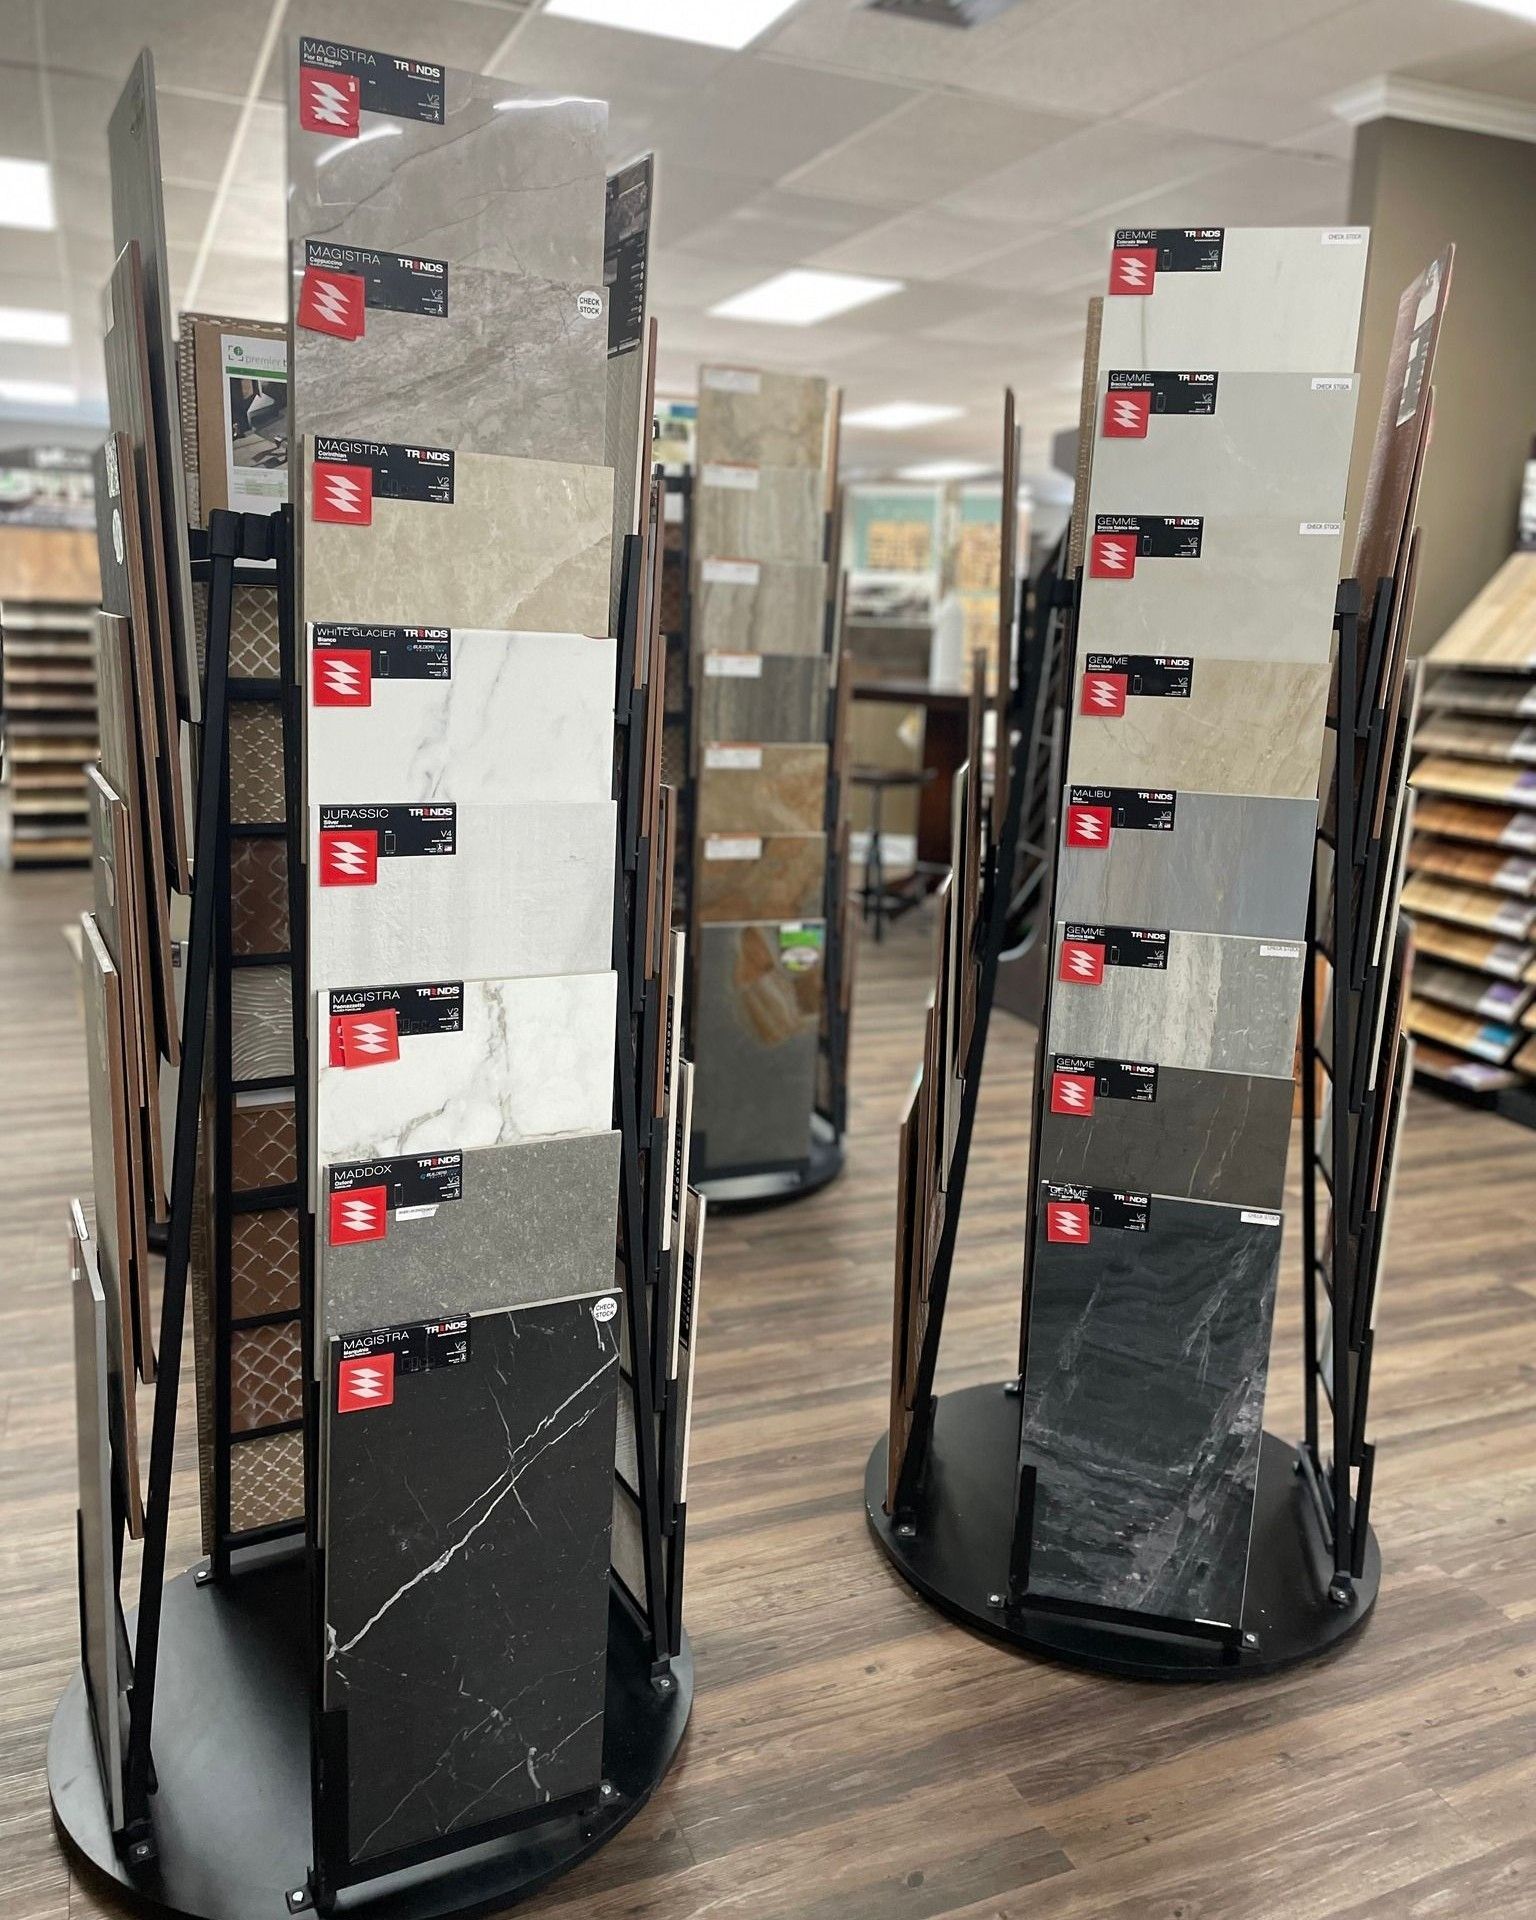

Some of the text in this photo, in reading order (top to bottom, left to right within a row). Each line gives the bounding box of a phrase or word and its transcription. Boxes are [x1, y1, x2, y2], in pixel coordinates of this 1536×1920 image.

[303, 41, 377, 66] MAGISTRA
[1116, 230, 1157, 240] GEMME
[309, 244, 381, 265] MAGISTRA
[579, 297, 600, 306] CHECK
[579, 306, 600, 315] STOCK
[245, 355, 282, 366] premier
[1110, 373, 1152, 382] GEMME
[318, 439, 389, 457] MAGISTRA
[437, 475, 450, 484] V2
[1097, 517, 1137, 525] GEMME
[317, 627, 396, 638] WHITE GLACIER
[435, 652, 448, 660] V4
[1088, 655, 1128, 666] GEMME
[1072, 788, 1112, 799] MALIBU
[323, 808, 390, 820] JURASSIC
[440, 829, 452, 838] V4
[1066, 925, 1106, 937] GEMME
[332, 990, 401, 1004] MAGISTRA
[446, 1007, 459, 1016] V2
[1056, 1057, 1096, 1069] GEMME
[334, 1164, 393, 1181] MADDOX
[334, 1179, 354, 1187] Oxford
[447, 1175, 460, 1184] V3
[1049, 1186, 1089, 1198] GEMME
[595, 1302, 615, 1312] CHECK
[595, 1310, 614, 1319] STOCK
[343, 1330, 410, 1350] MAGISTRA
